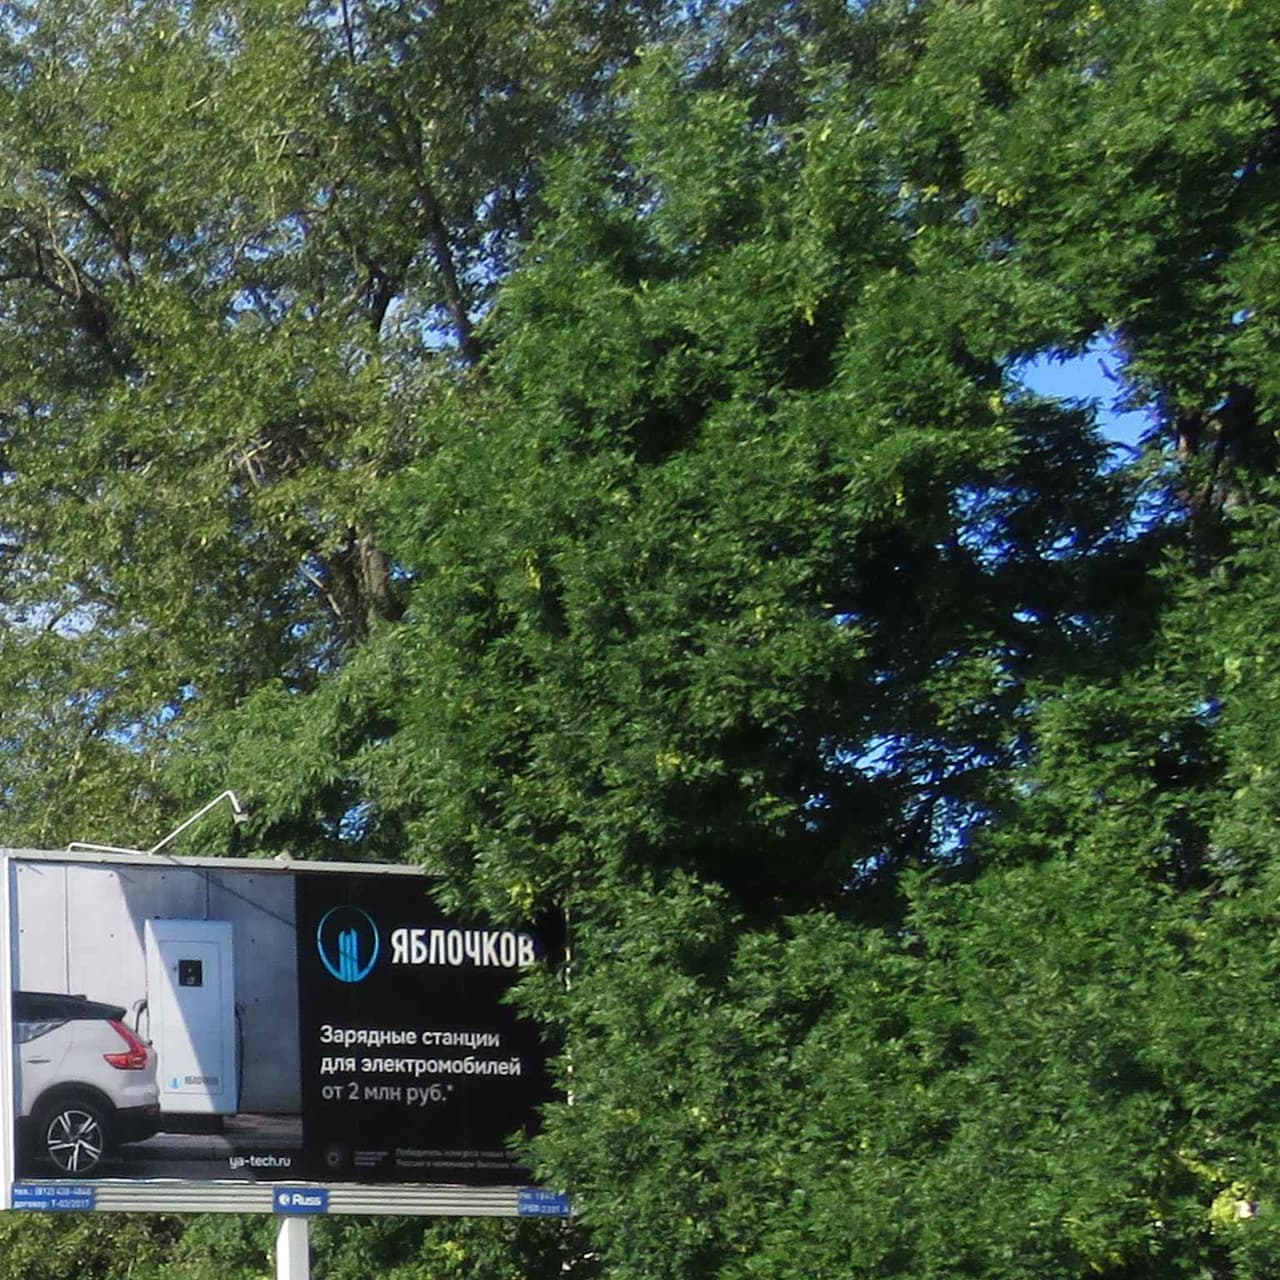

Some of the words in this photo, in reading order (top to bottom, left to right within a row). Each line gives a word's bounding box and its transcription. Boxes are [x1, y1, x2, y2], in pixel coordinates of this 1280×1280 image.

[391, 928, 535, 968] ЯБЛОЧКОВ
[319, 1025, 417, 1048] Зарядные
[422, 1030, 500, 1049] станции
[320, 1057, 356, 1075] для
[361, 1056, 521, 1077] электромобилей
[321, 1085, 343, 1100] от
[348, 1082, 359, 1100] 2
[364, 1086, 401, 1101] млн
[228, 1155, 292, 1170] ya-tech.ru
[292, 1193, 321, 1206] Russ
